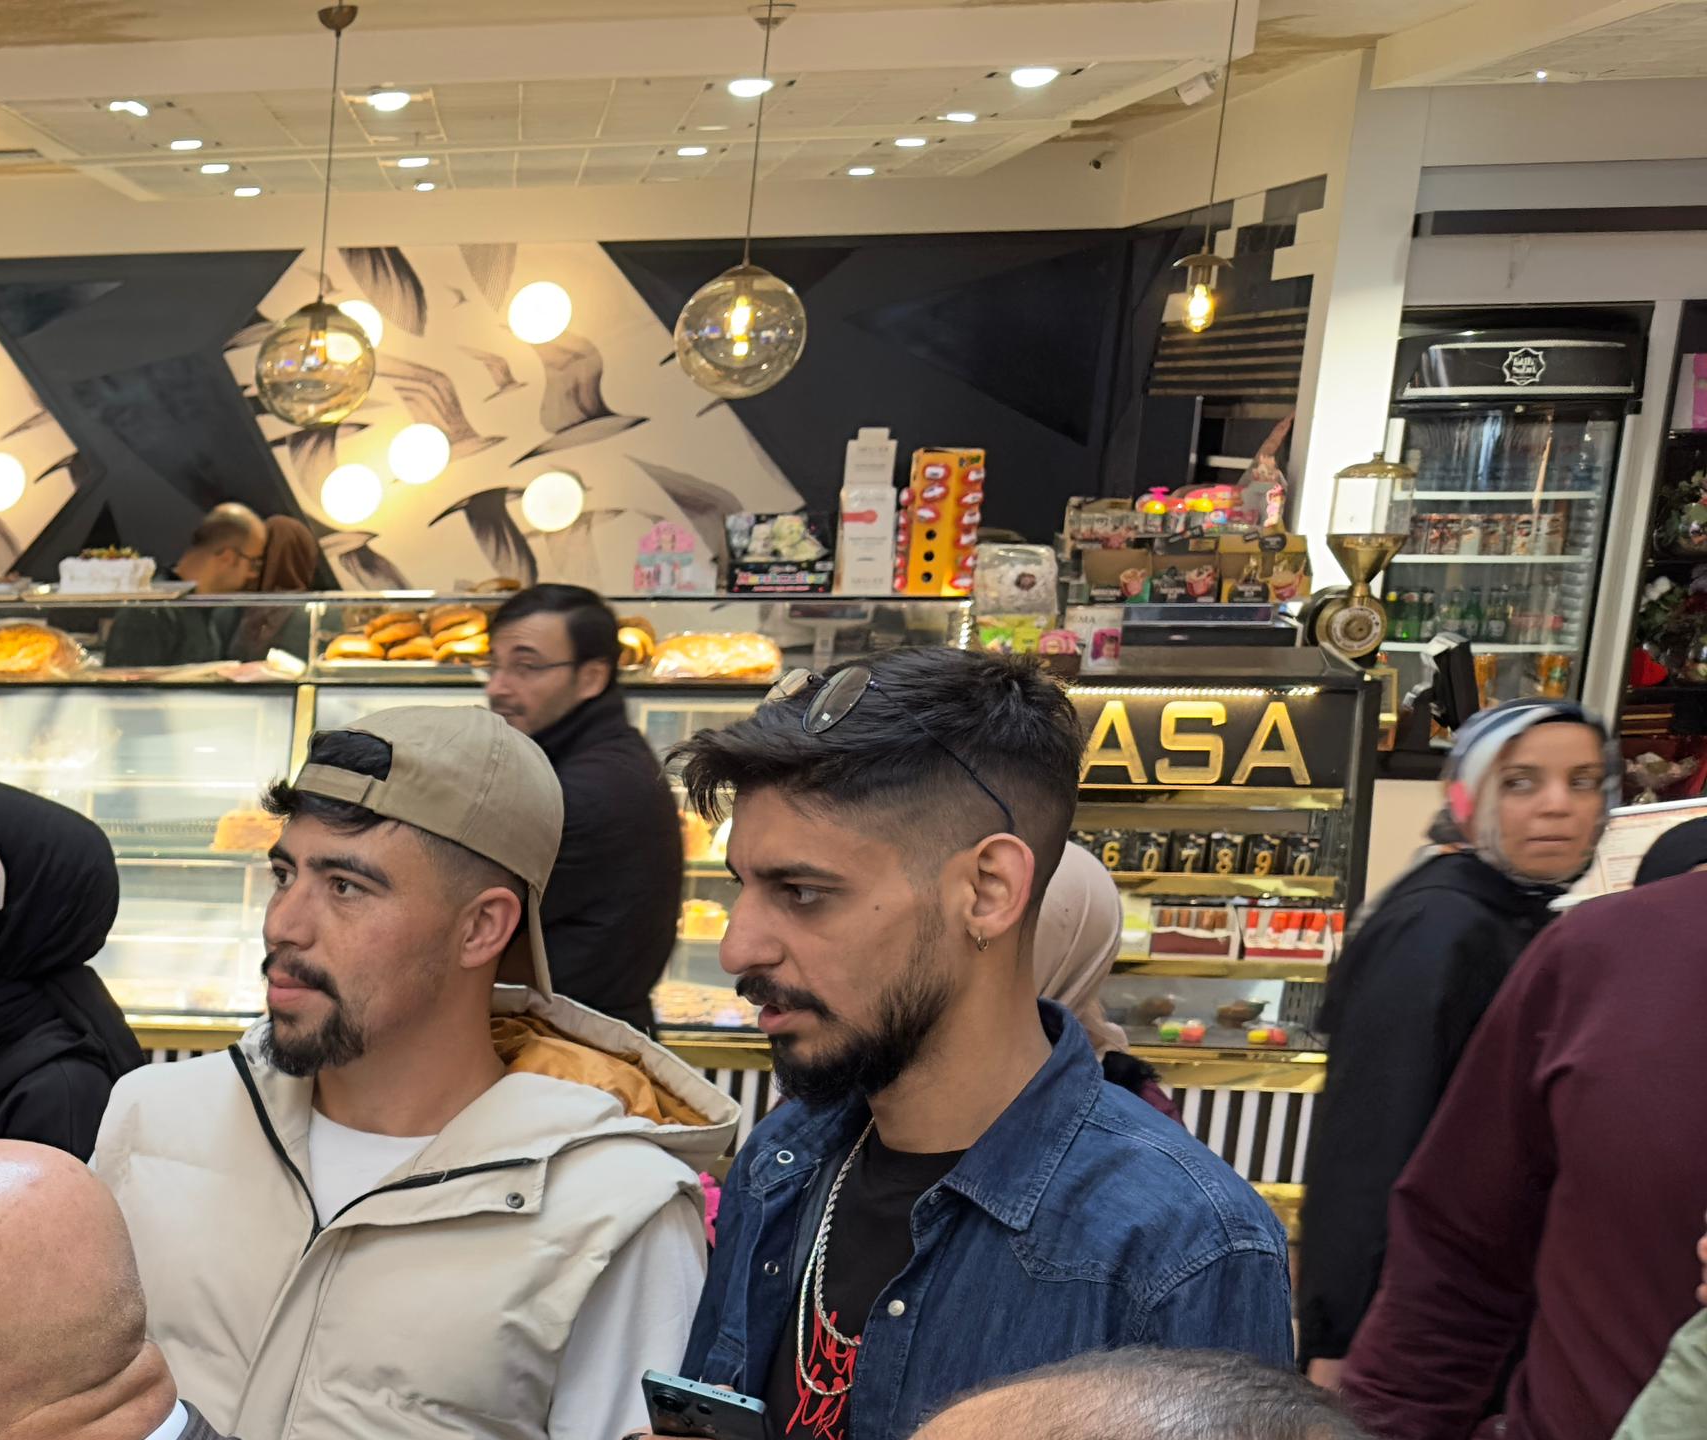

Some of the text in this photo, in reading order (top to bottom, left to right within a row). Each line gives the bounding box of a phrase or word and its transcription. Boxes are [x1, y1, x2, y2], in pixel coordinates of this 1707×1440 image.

[1102, 841, 1121, 868] 6
[1142, 849, 1161, 873] 0
[1180, 848, 1200, 874] 7
[1215, 848, 1234, 875] 8
[1253, 851, 1273, 877] 9
